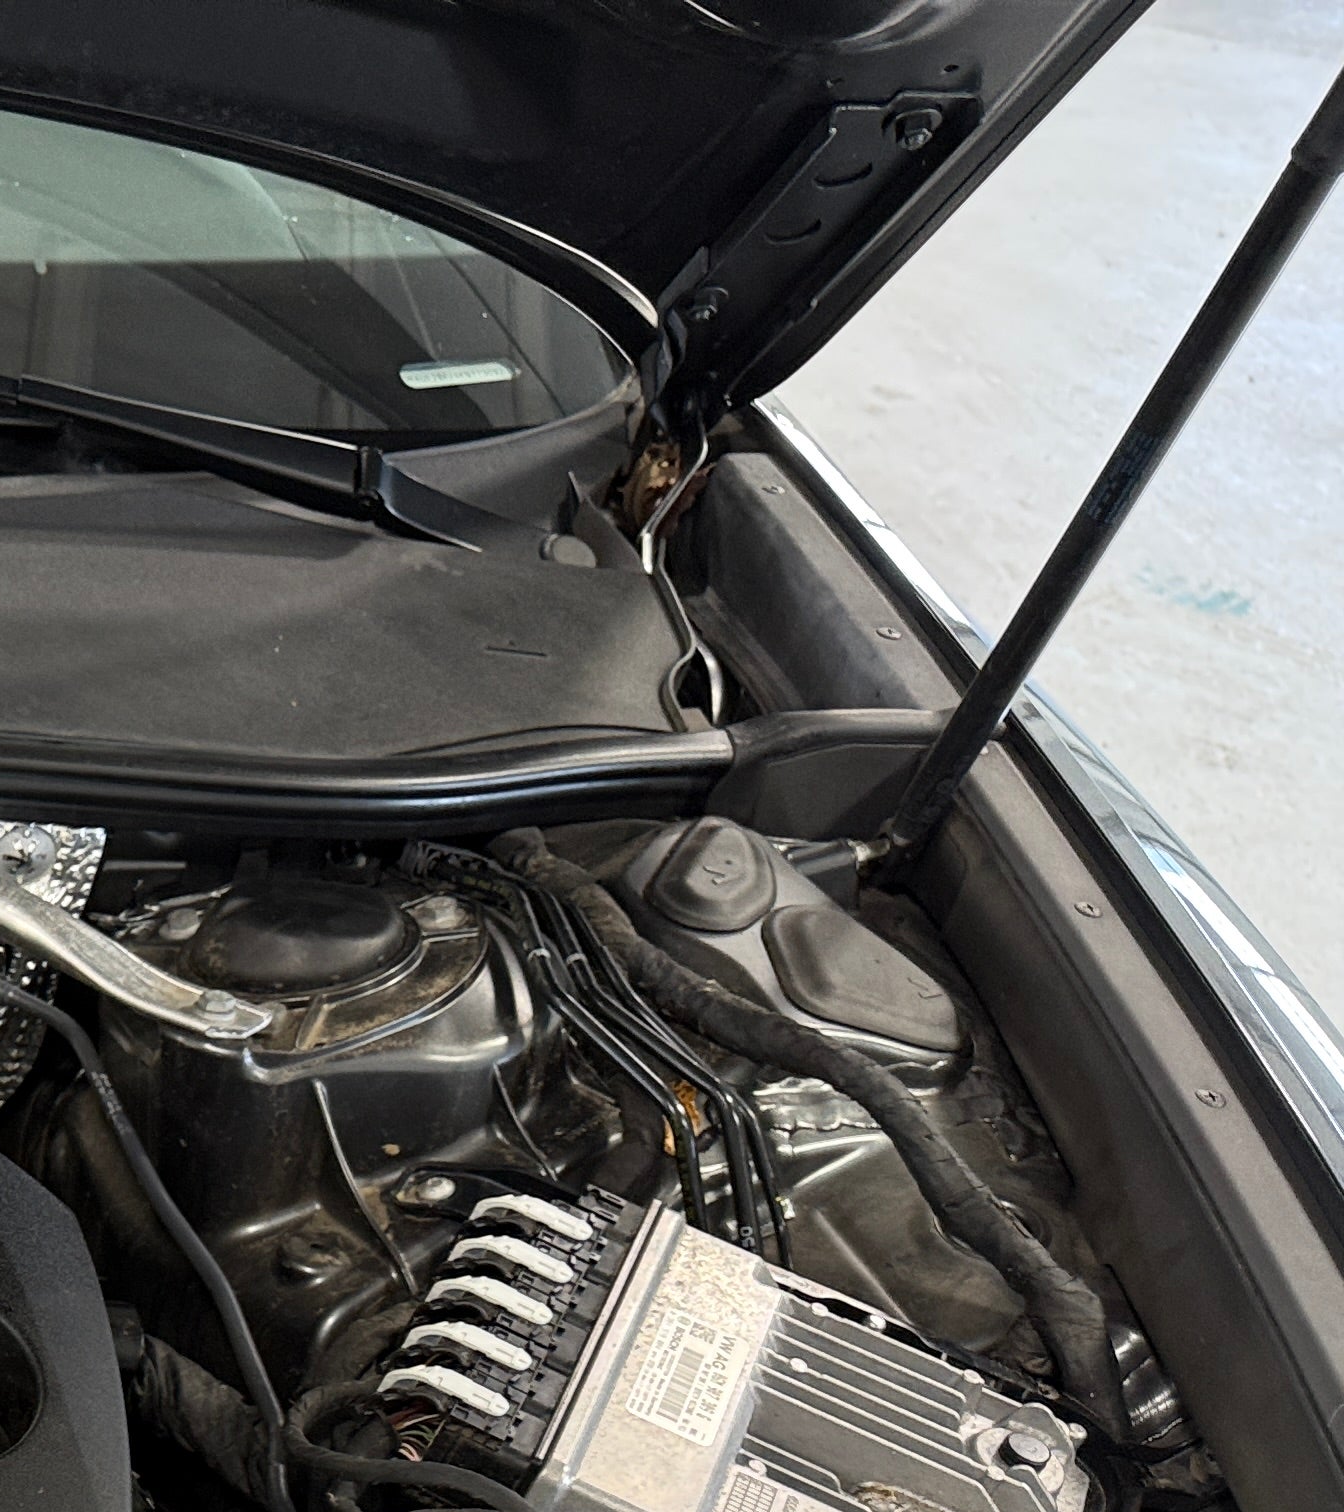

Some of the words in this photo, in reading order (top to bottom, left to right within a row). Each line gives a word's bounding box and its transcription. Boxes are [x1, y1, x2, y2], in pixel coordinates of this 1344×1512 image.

[668, 1326, 686, 1352] BOSCH
[718, 1335, 737, 1356] VW
[712, 1352, 729, 1371] AG
